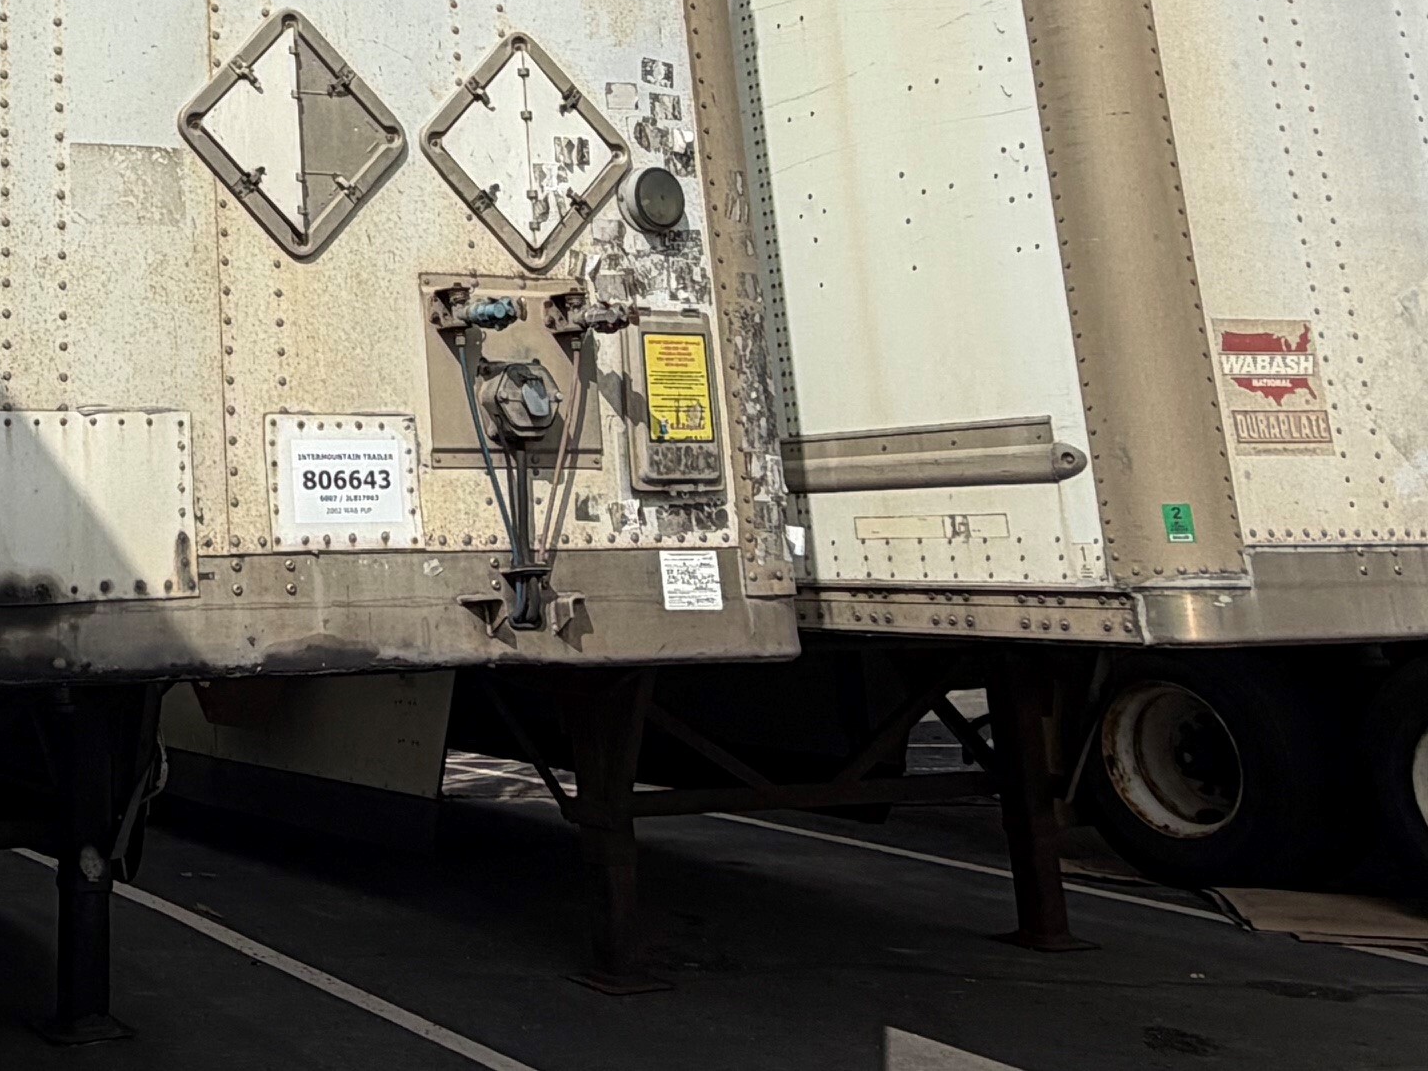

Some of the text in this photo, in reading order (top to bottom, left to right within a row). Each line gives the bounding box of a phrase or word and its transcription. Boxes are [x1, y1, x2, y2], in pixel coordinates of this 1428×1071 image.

[1221, 355, 1314, 375] WABASH
[1235, 414, 1329, 440] DURAPLATE
[297, 453, 394, 461] INTERMOUNTAIN TRAILER
[302, 469, 391, 490] 806643
[1171, 506, 1183, 519] 2
